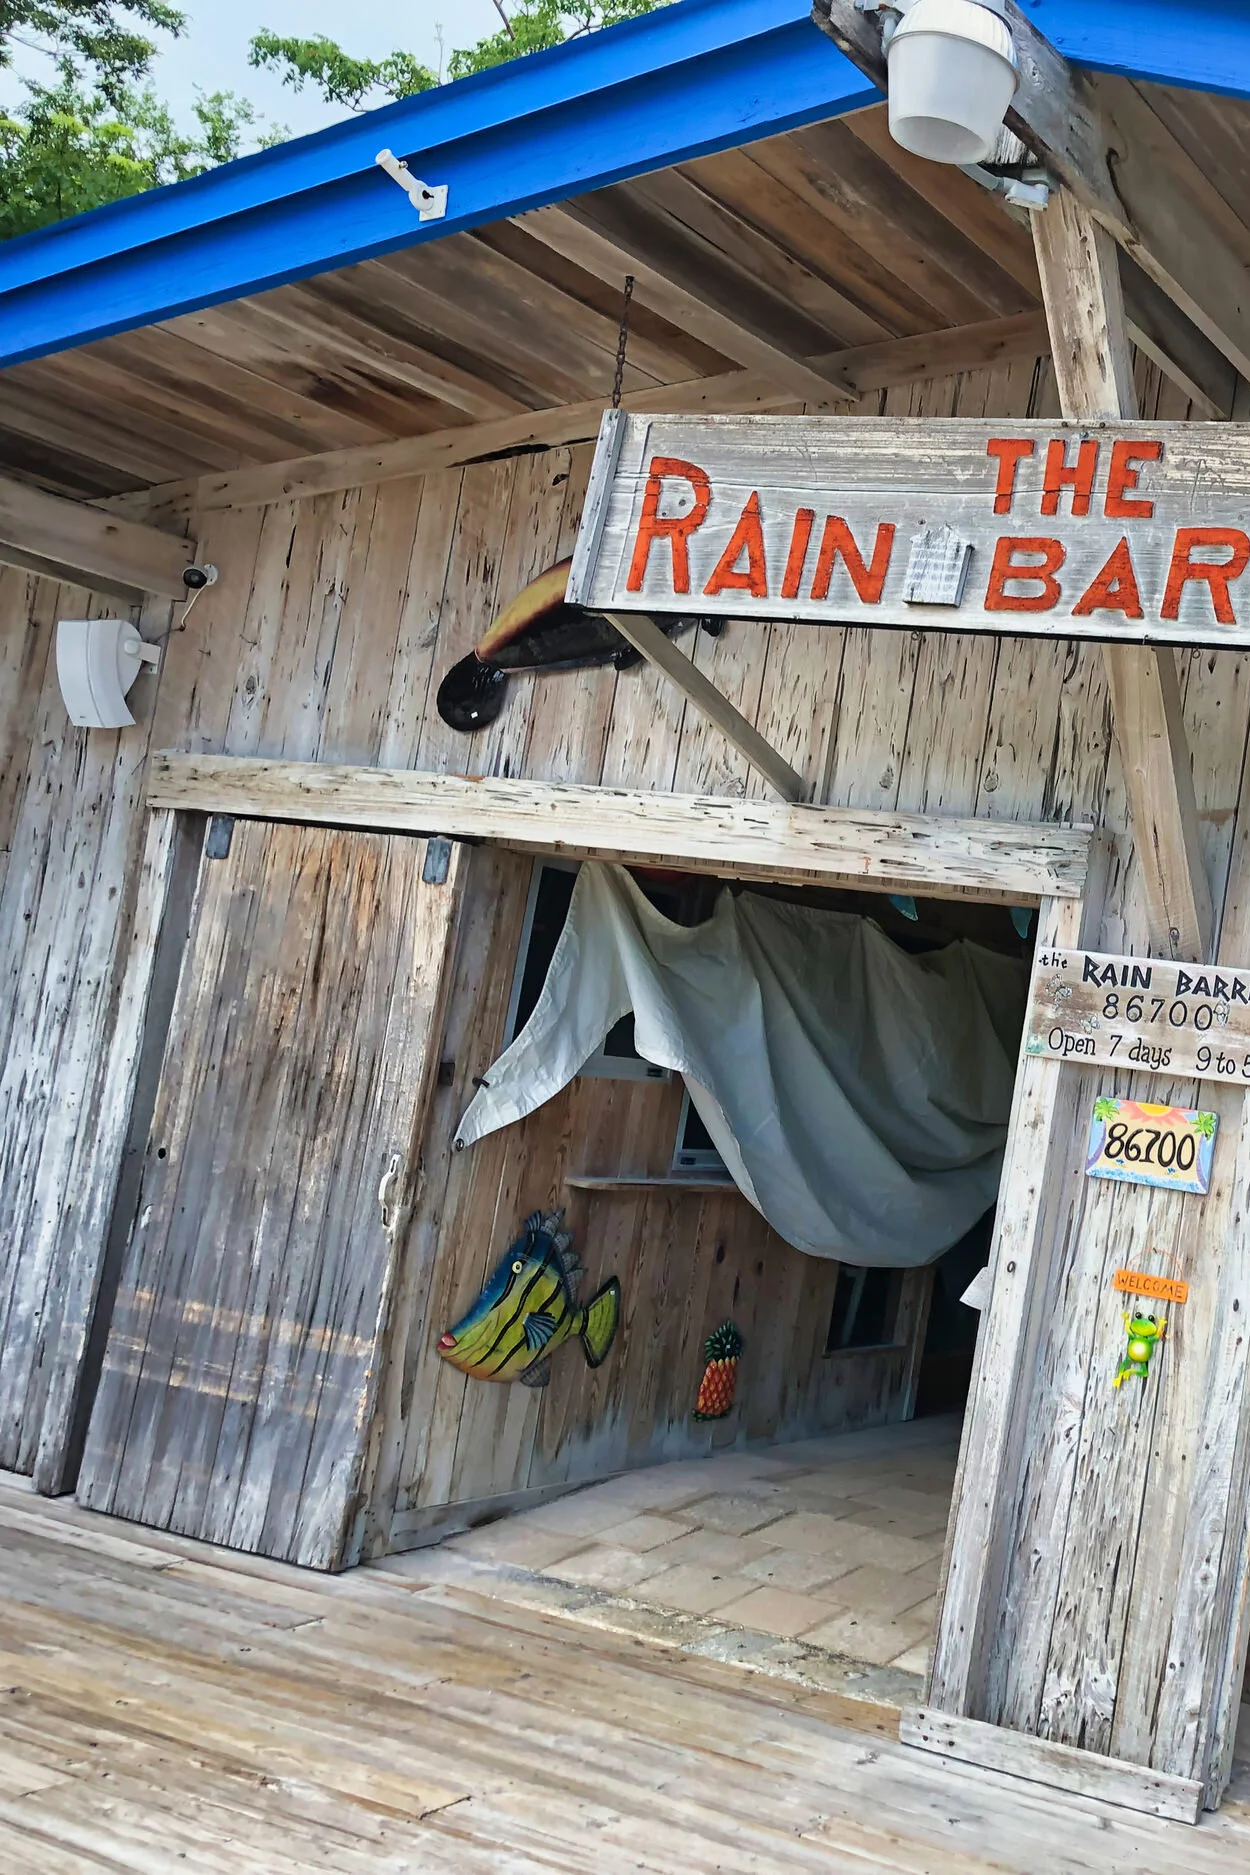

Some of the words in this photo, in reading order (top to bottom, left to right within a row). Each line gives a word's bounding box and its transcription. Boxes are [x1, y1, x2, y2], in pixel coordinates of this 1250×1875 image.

[986, 438, 1161, 518] THE
[626, 456, 895, 604] RAIN
[1038, 952, 1068, 969] the
[1082, 955, 1152, 990] RAIN
[1102, 993, 1214, 1031] 86700
[1048, 1027, 1097, 1056] Open
[1109, 1034, 1123, 1057] 7
[1128, 1037, 1173, 1070] days
[1195, 1046, 1212, 1072] 9
[1215, 1051, 1237, 1075] to
[1103, 1122, 1196, 1171] 86700
[1117, 1272, 1185, 1299] WELCOME
